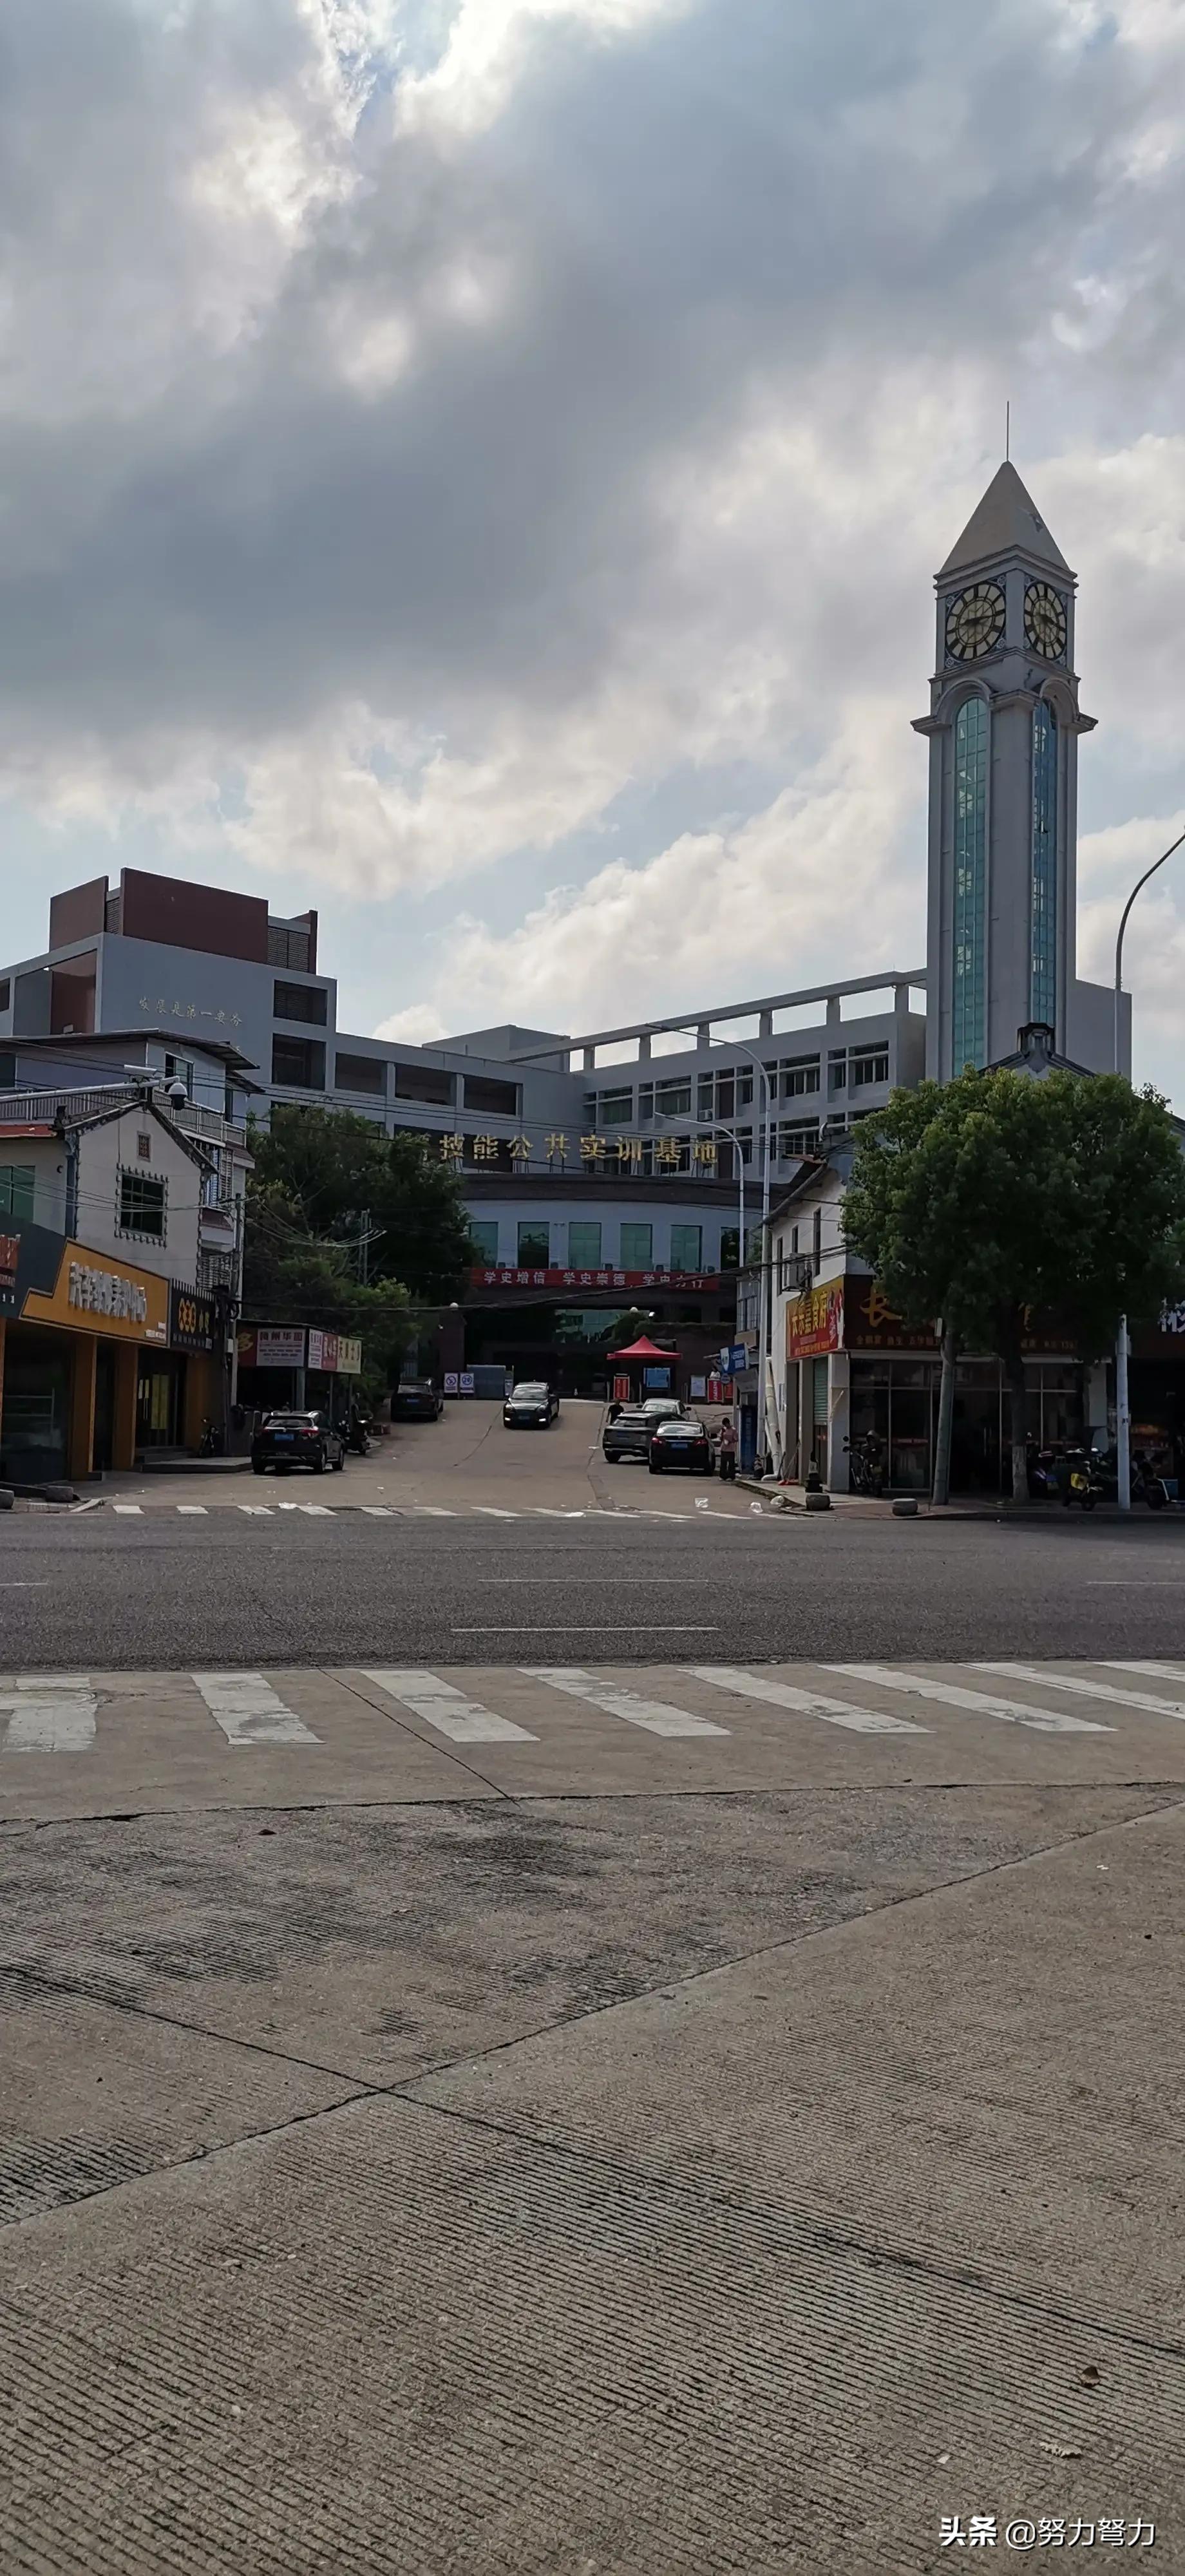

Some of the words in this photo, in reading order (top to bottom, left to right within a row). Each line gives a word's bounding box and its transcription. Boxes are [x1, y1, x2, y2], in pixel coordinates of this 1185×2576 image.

[439, 1133, 719, 1164] 技能公共实训基地
